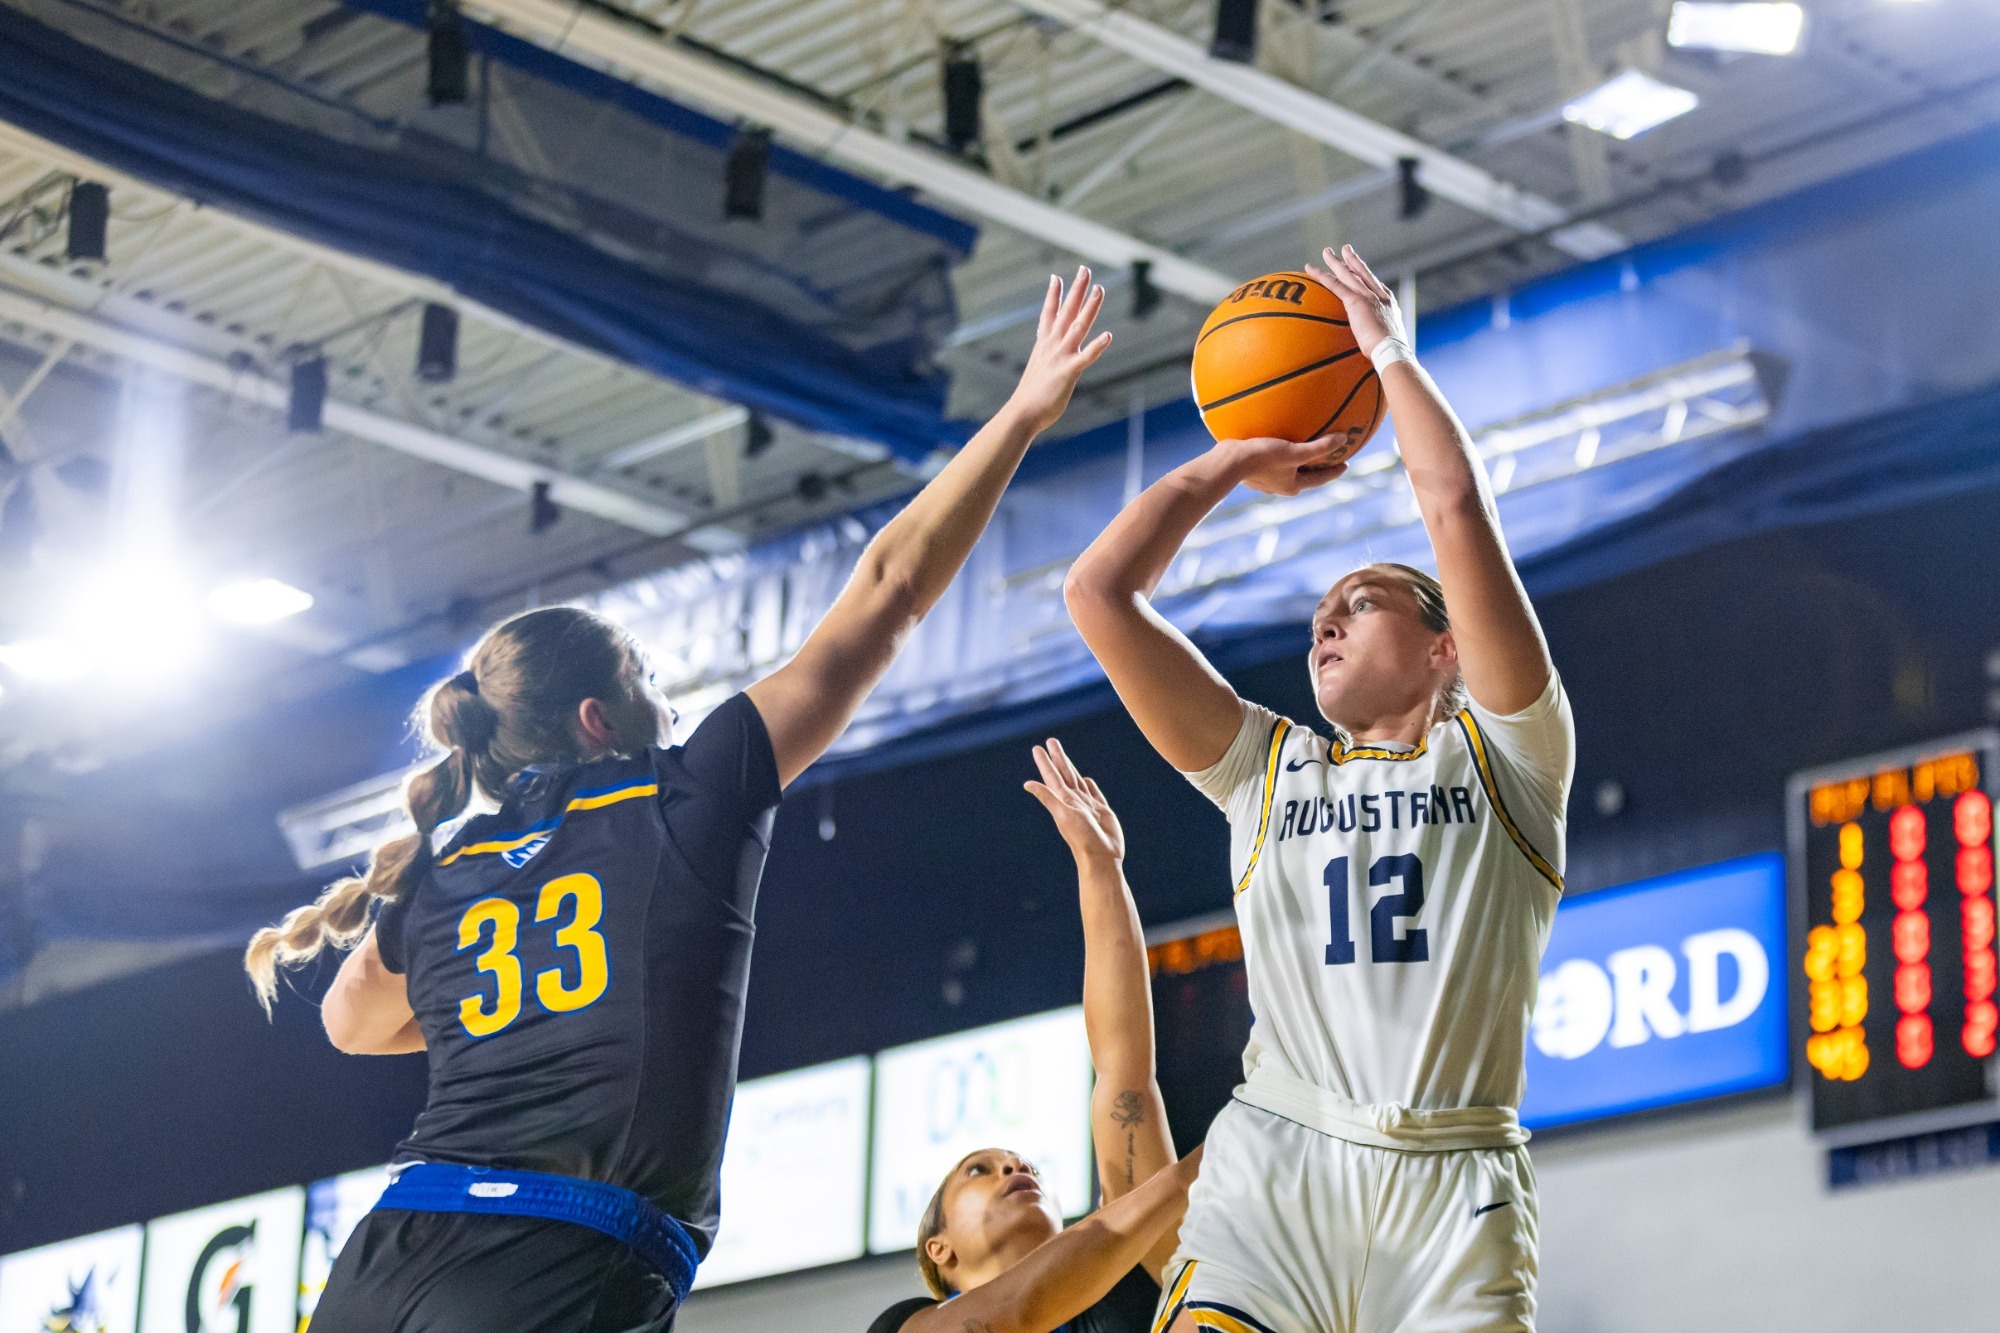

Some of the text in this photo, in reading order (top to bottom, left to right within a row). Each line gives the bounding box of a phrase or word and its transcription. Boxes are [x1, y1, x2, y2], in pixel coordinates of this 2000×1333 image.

[1227, 280, 1307, 306] Wil
[1278, 784, 1476, 842] AUGUSTANA
[1323, 852, 1430, 966] 12
[456, 870, 611, 1040] 33
